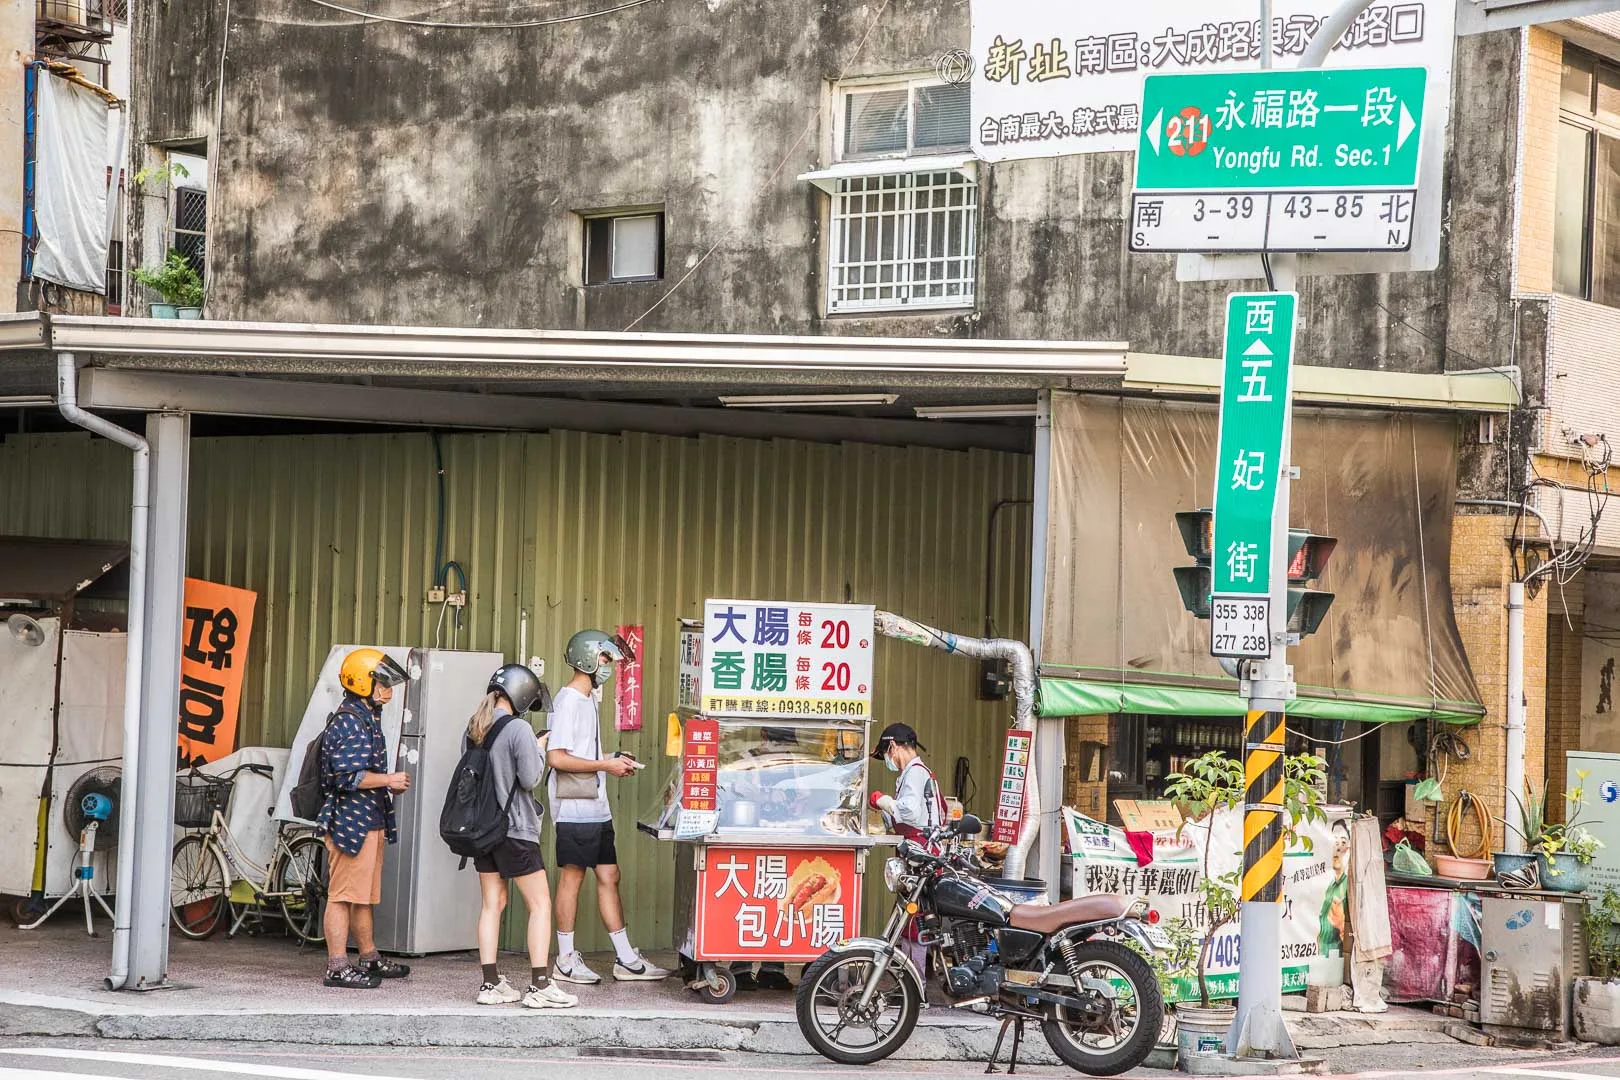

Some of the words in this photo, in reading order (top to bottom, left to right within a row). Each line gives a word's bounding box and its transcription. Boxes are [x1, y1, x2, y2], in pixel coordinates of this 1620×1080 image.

[984, 35, 1071, 85] 新址
[1075, 3, 1425, 75] 南區:大成路與永路口
[1214, 86, 1398, 132] 永福路一段
[1167, 116, 1212, 148] 211
[1212, 145, 1281, 174] Yongfu
[1291, 144, 1324, 169] Rd.
[1137, 200, 1164, 229] 南
[1193, 196, 1254, 221] 3-39
[1284, 195, 1364, 220] 43-85
[1379, 195, 1409, 224] 北
[1134, 232, 1150, 247] S.
[1387, 230, 1406, 246] N.
[1245, 300, 1276, 336] 西
[1226, 359, 1273, 583] 五妃街
[711, 606, 789, 647] 大腸
[797, 611, 813, 647] 每條
[1215, 604, 1238, 620] 355
[1243, 605, 1265, 621] 338
[820, 620, 850, 649] 20
[1215, 635, 1237, 651] 277
[1243, 636, 1266, 651] 238
[711, 650, 788, 693] 香腸
[795, 656, 811, 692] 每條
[821, 662, 851, 692] 20
[713, 854, 787, 900] 大腸
[734, 903, 845, 949] 包小腸
